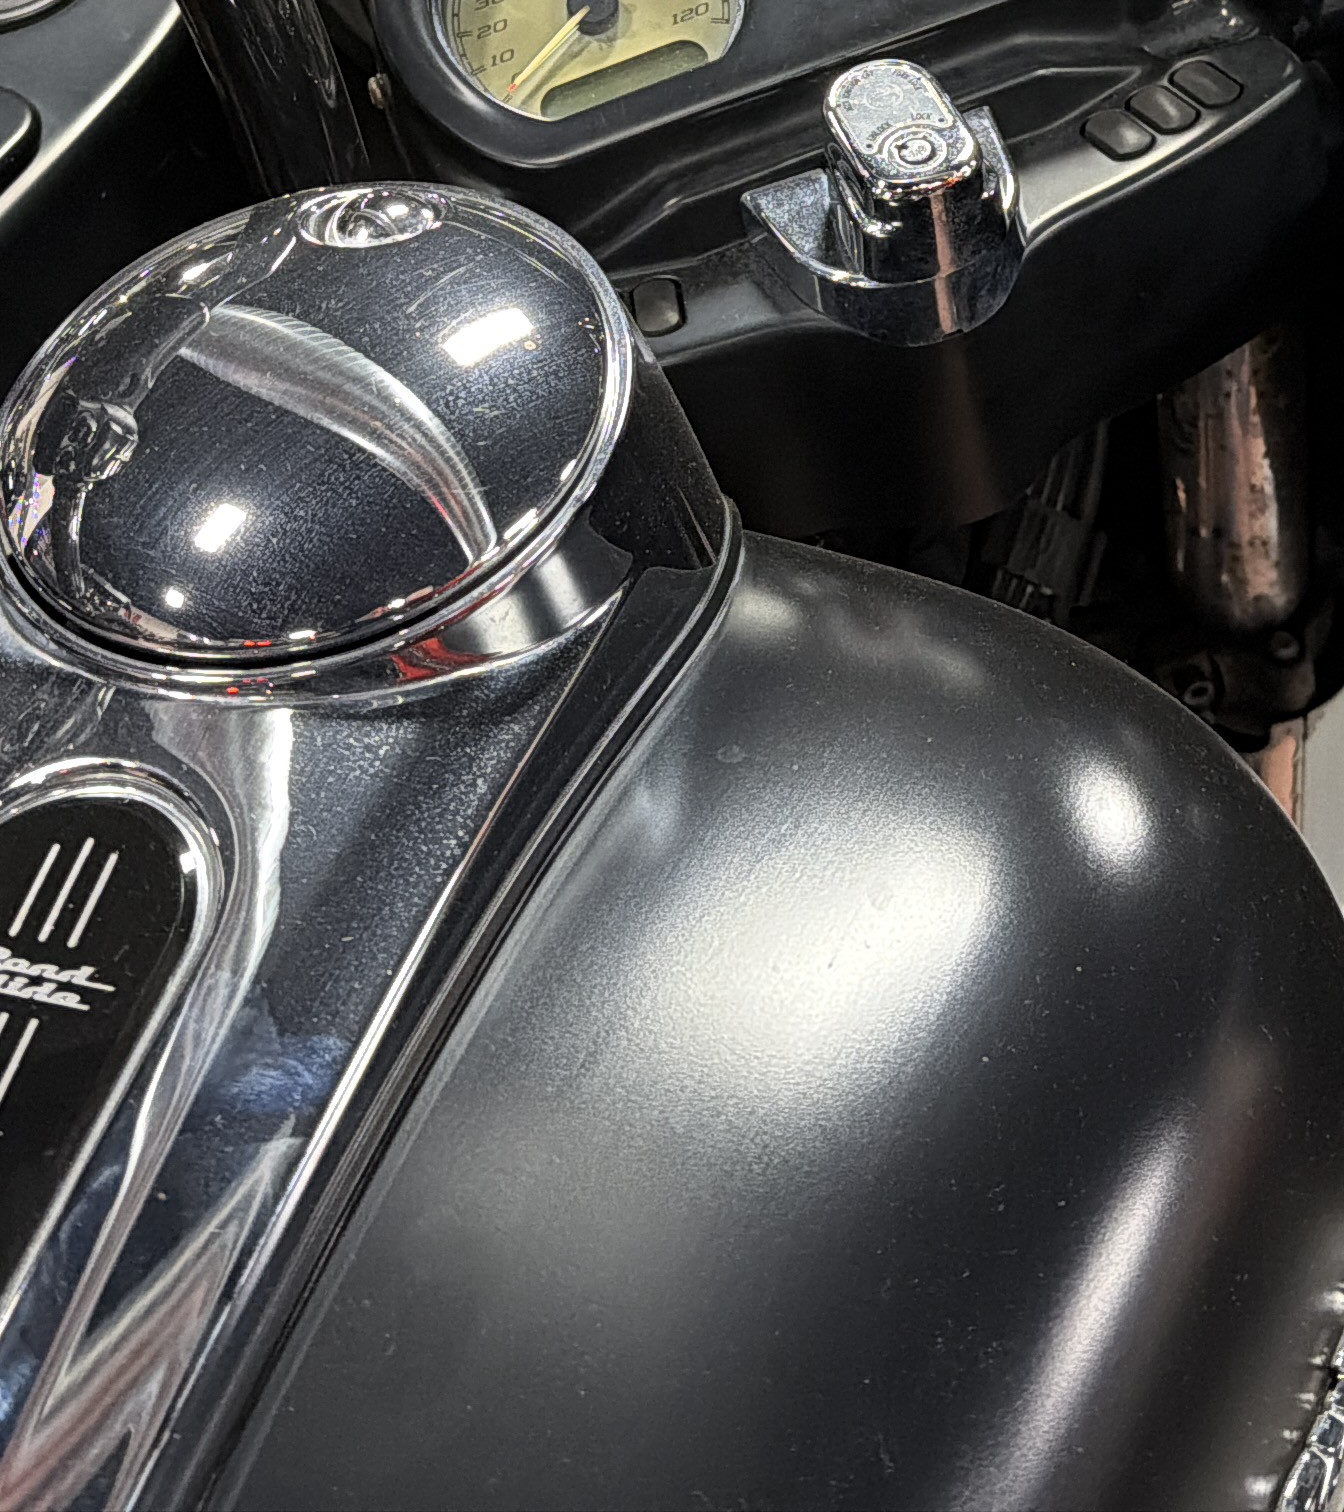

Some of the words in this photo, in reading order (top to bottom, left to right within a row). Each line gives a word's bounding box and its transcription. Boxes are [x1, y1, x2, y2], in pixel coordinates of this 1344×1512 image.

[672, 2, 710, 26] 120
[477, 19, 508, 39] 20
[491, 48, 515, 67] 10
[911, 113, 933, 121] LOCK
